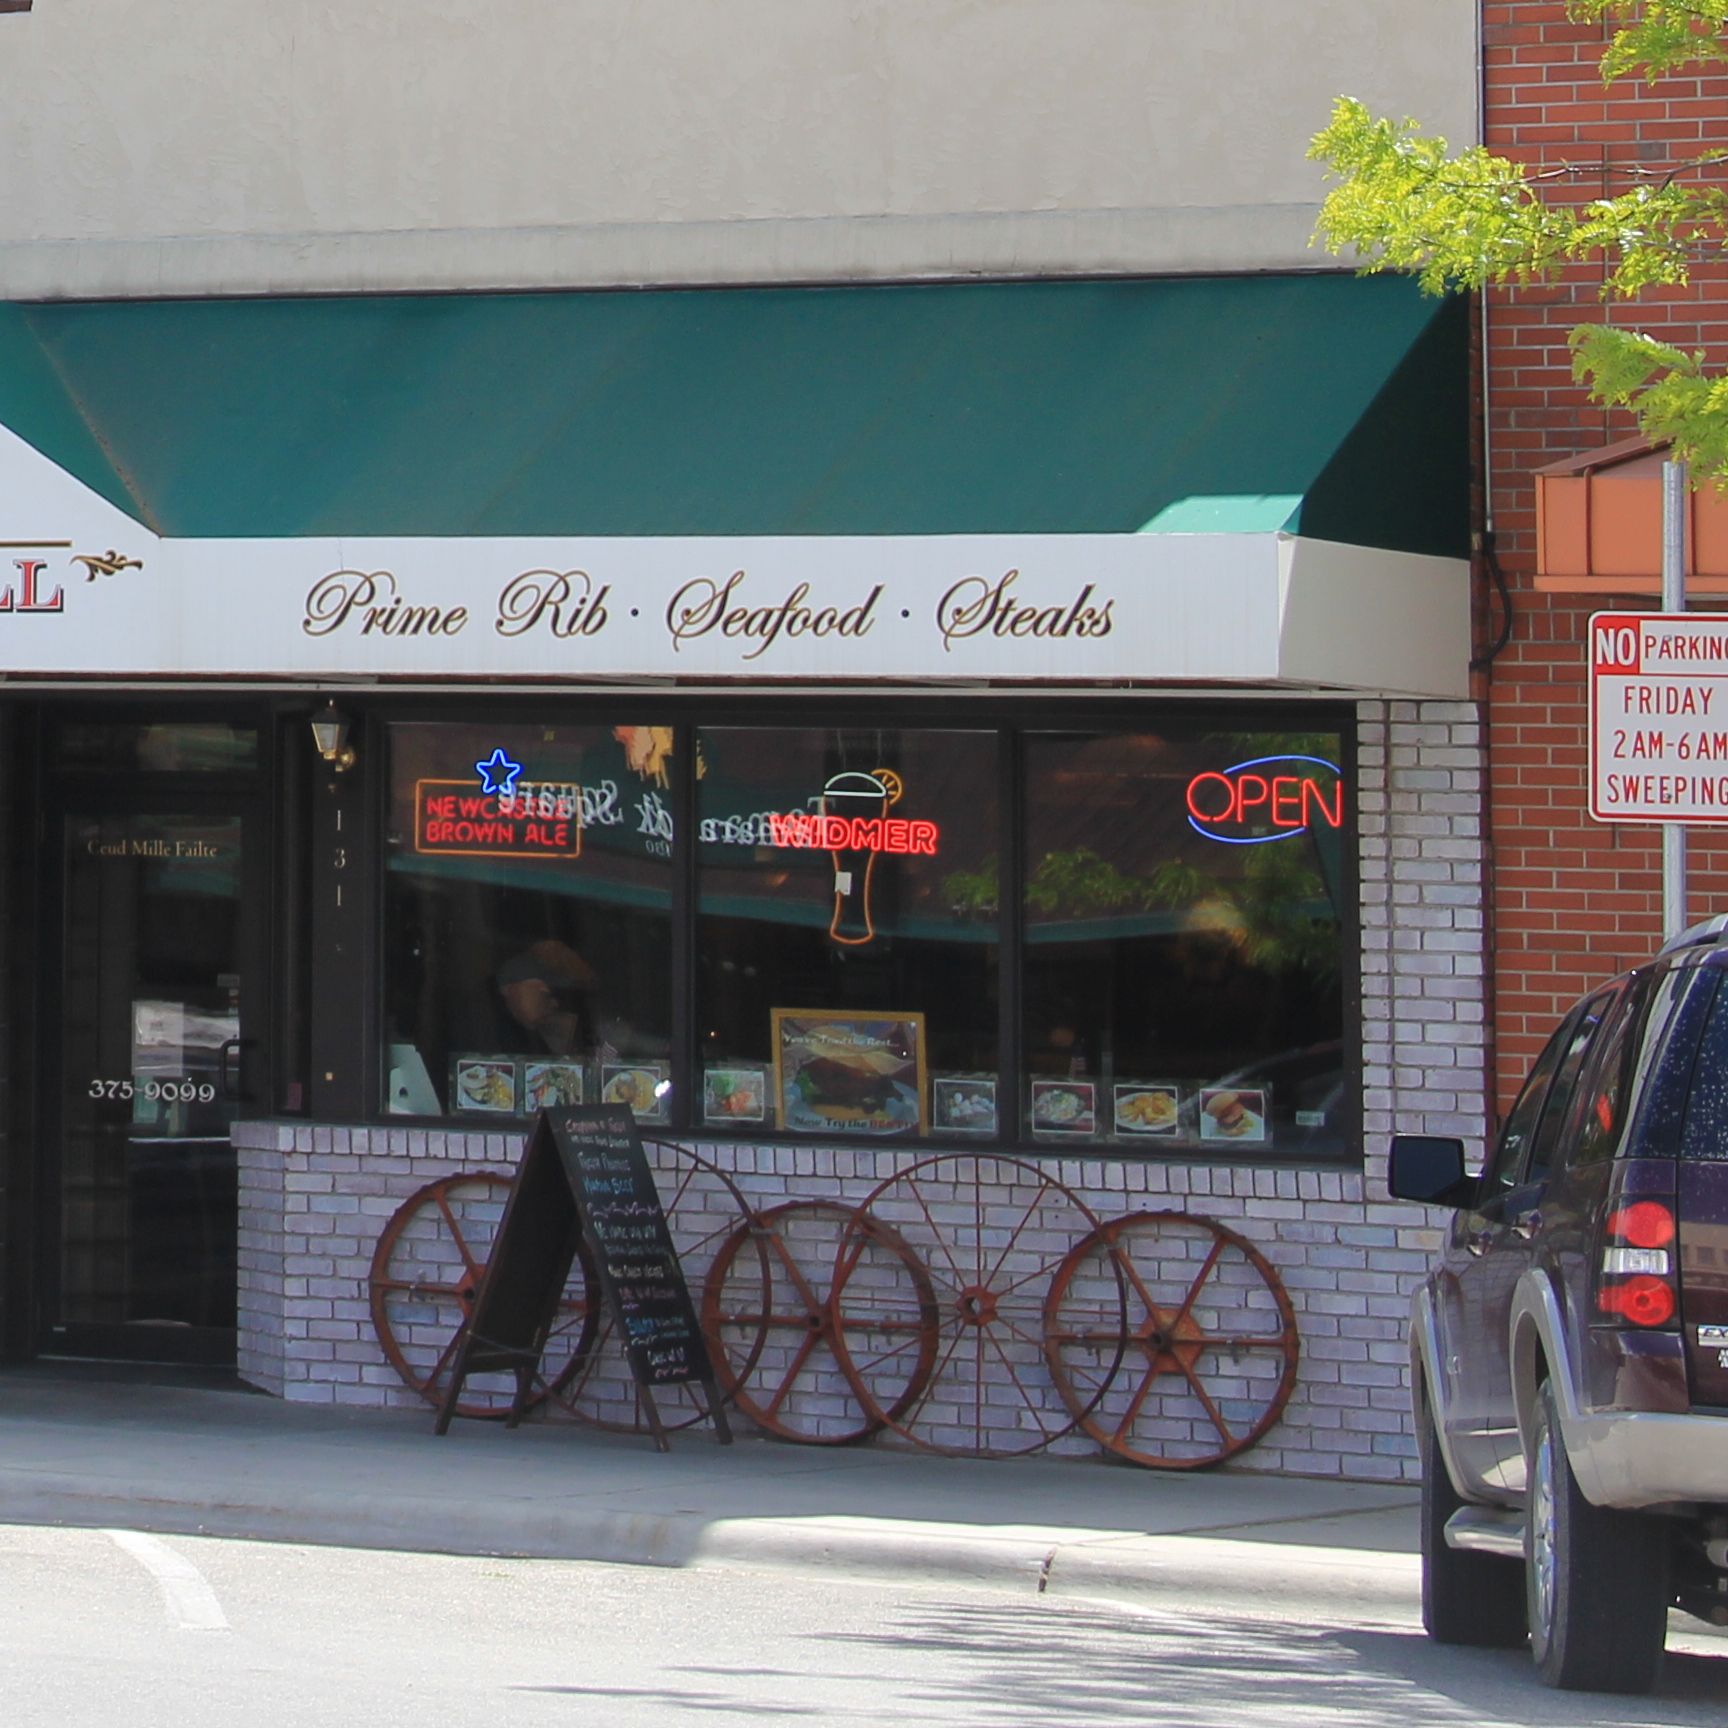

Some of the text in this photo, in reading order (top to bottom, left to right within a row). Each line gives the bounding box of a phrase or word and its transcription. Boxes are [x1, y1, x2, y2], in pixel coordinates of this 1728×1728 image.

[303, 569, 1115, 660] Prime Rib Seafood Steaks
[1596, 628, 1636, 666] NO
[1624, 686, 1713, 715] FRIDAY
[1187, 772, 1343, 828] OPEN
[87, 839, 127, 856] Ceud
[132, 839, 171, 857] Mille
[425, 821, 568, 846] BROWN ALE
[768, 814, 939, 856] WIDMER
[88, 1079, 216, 1103] 375-9099
[825, 1118, 846, 1129] Try
